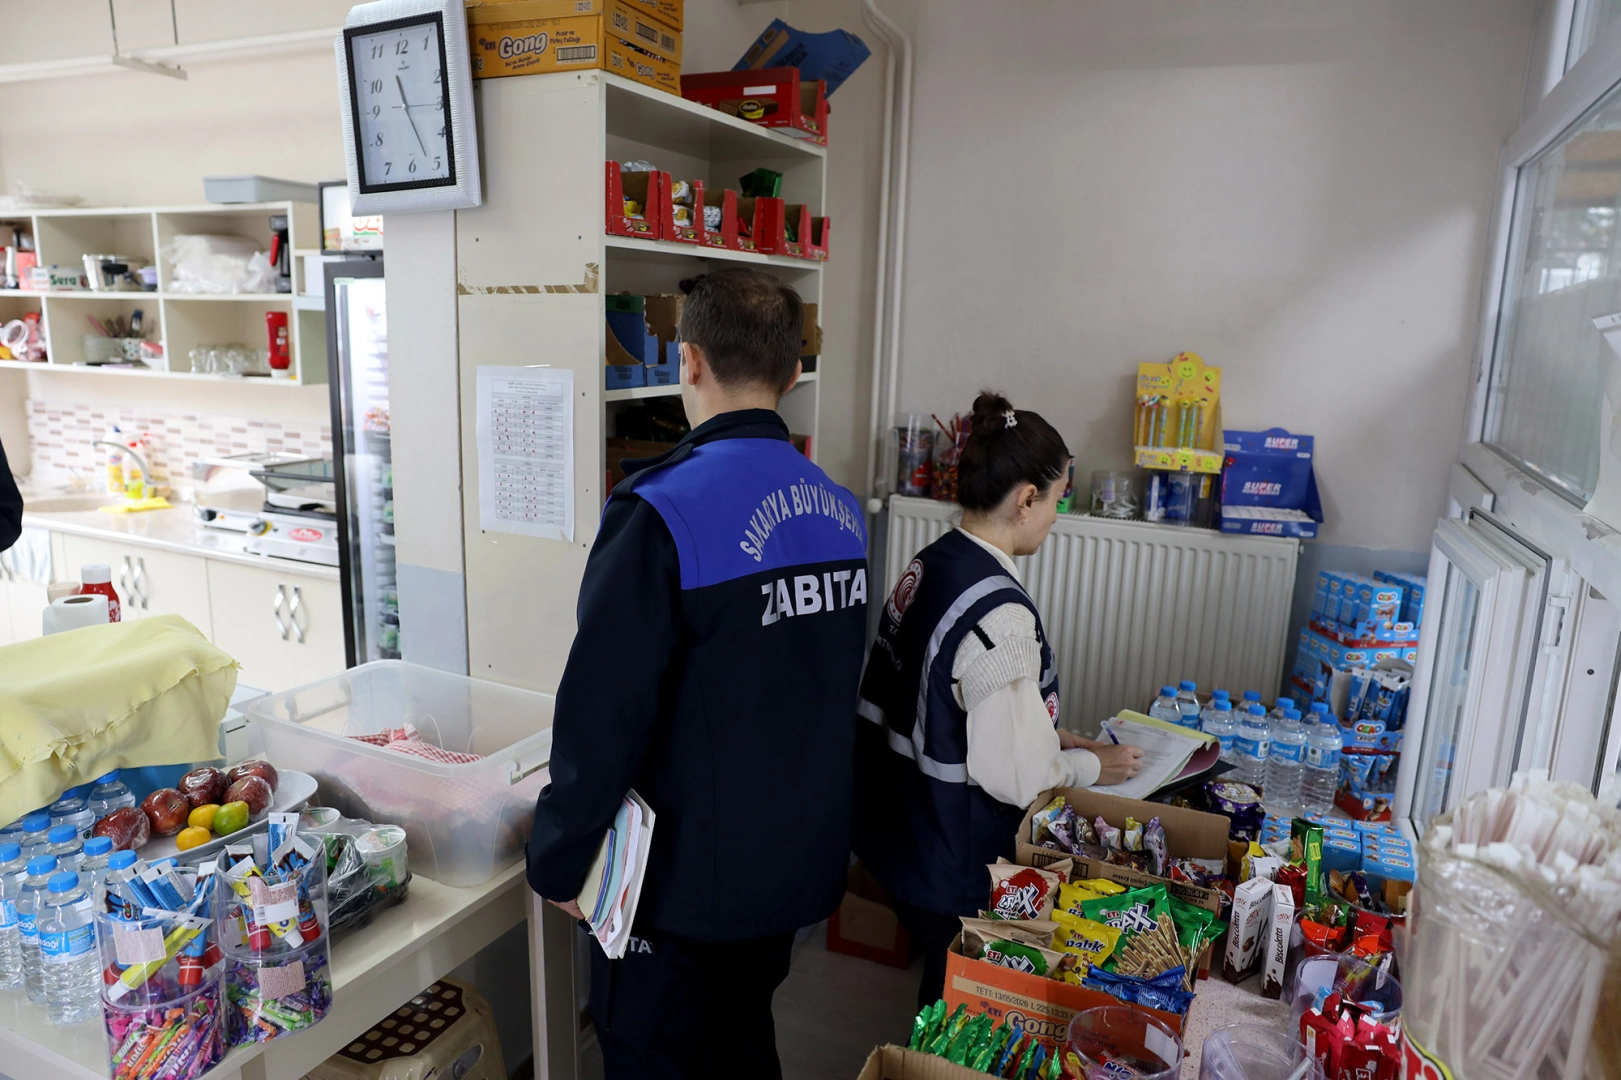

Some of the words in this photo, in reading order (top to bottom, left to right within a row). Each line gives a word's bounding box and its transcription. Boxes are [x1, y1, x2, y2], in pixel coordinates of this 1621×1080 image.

[395, 39, 409, 56] 12
[423, 35, 430, 50] 1
[498, 32, 548, 60] Gong
[371, 44, 384, 60] 11
[434, 68, 442, 84] 2
[370, 79, 383, 95] 10
[436, 96, 444, 111] 3
[372, 105, 381, 120] 9
[375, 132, 384, 147] 8
[438, 125, 447, 139] 4
[384, 162, 392, 176] 7
[408, 158, 417, 174] 6
[432, 156, 442, 171] 5
[1265, 437, 1299, 447] SUPER
[1244, 482, 1282, 492] SUPER
[740, 489, 792, 562] SAKARYA
[1252, 522, 1283, 532] SUPER
[761, 568, 867, 627] ZABITA
[1356, 723, 1384, 735] OZMO
[1232, 910, 1240, 950] Biscolata
[1275, 928, 1284, 964] Biscolata
[986, 950, 1002, 960] ETi
[976, 985, 994, 998] TETT:
[994, 990, 1030, 1008] 13/05/2026
[1036, 1003, 1050, 1015] 225
[1051, 1008, 1070, 1020] 13:33
[1004, 1010, 1071, 1042] Gong
